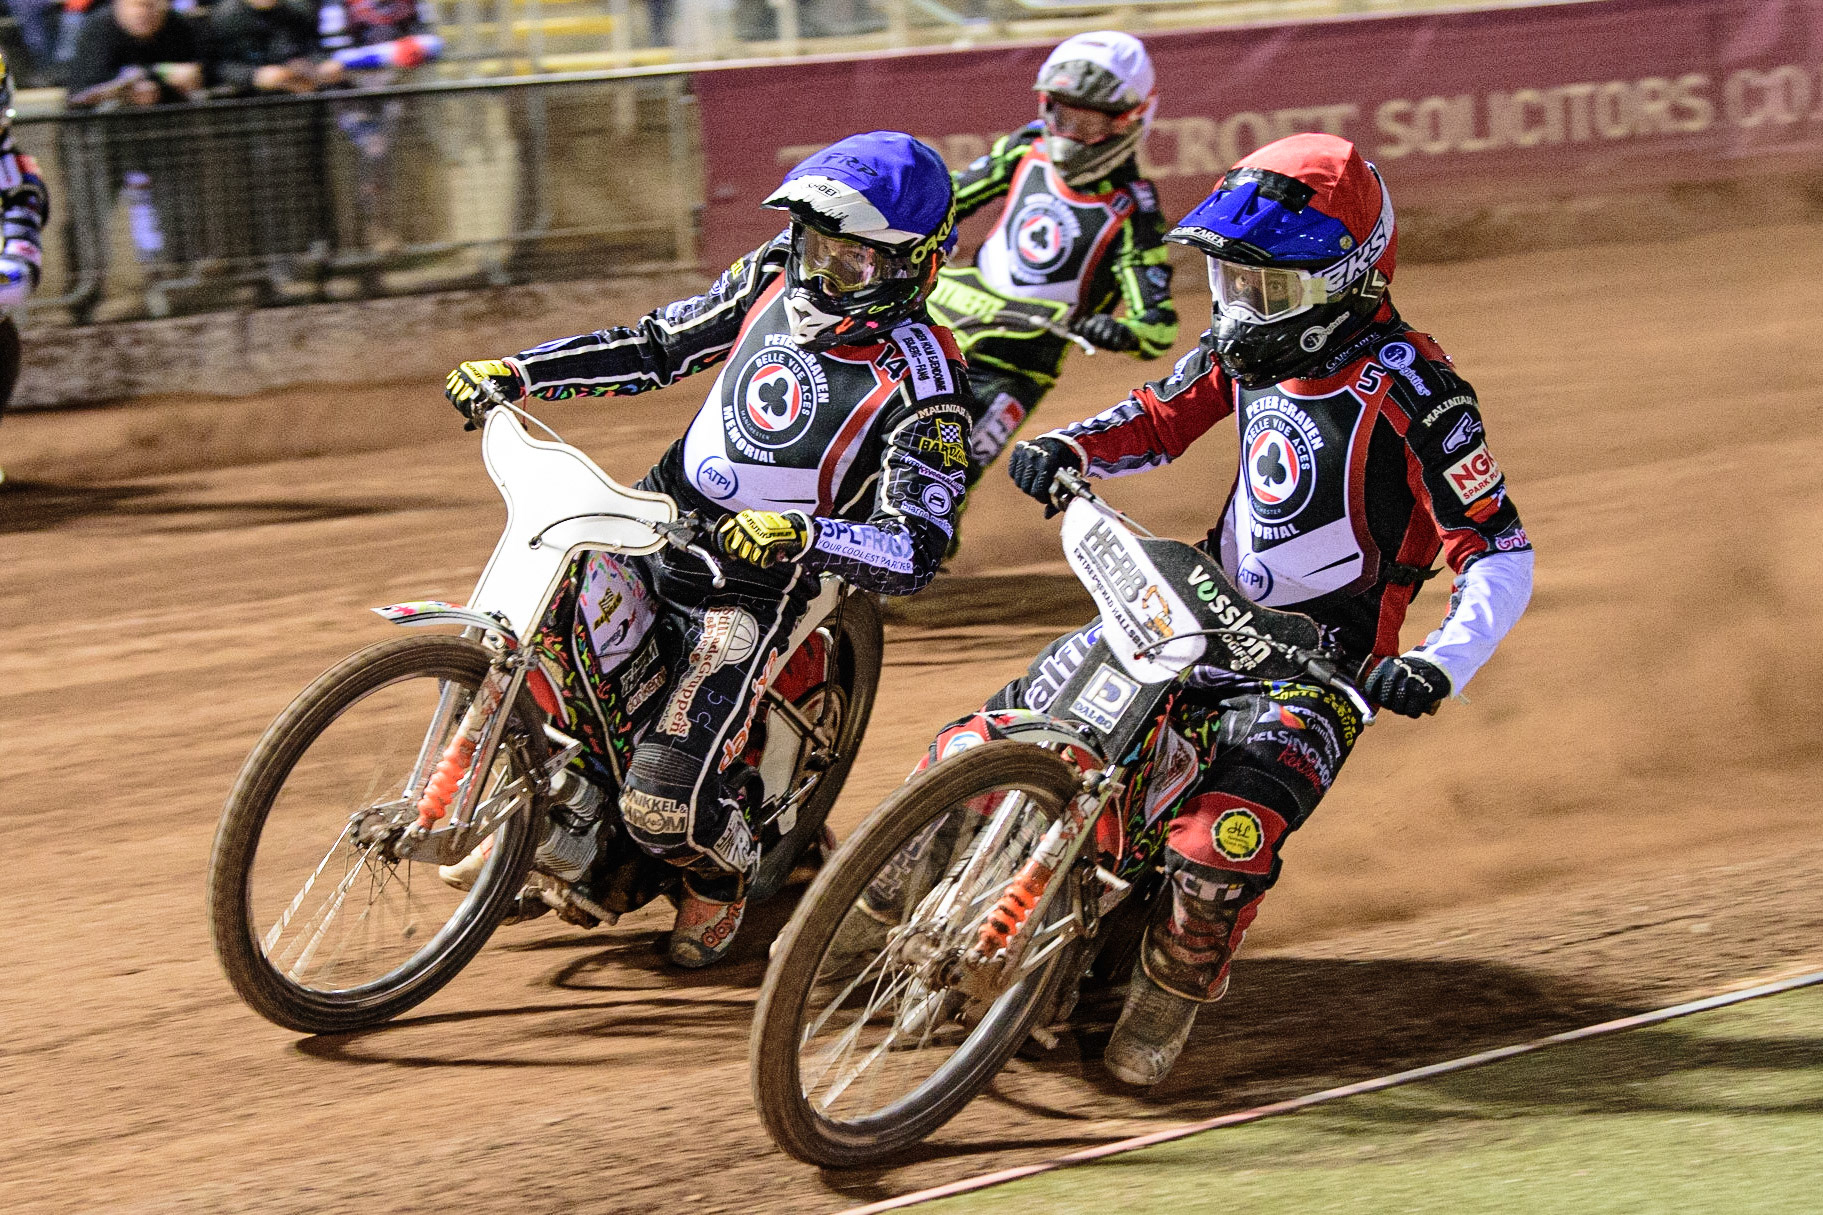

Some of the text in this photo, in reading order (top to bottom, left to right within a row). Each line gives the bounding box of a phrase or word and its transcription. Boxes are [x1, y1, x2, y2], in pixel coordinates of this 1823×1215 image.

[1376, 73, 1713, 158] SOLICITORS
[807, 182, 838, 197] SHOEI
[875, 343, 909, 383] 14
[1357, 361, 1387, 395] 5
[755, 352, 812, 416] BELLE VUE ACES
[723, 405, 776, 463] MEMORIAL
[1245, 395, 1325, 451] PETER CRAVEN
[1272, 418, 1292, 437] VUE
[1292, 437, 1310, 471] ACES
[703, 467, 731, 490] ATPI
[1463, 478, 1490, 500] SPARK
[1250, 517, 1300, 540] ORIAL
[818, 540, 841, 552] YOUR
[842, 546, 880, 563] COOLEST
[1238, 567, 1264, 589] ATPI
[1219, 632, 1257, 671] OGIFER
